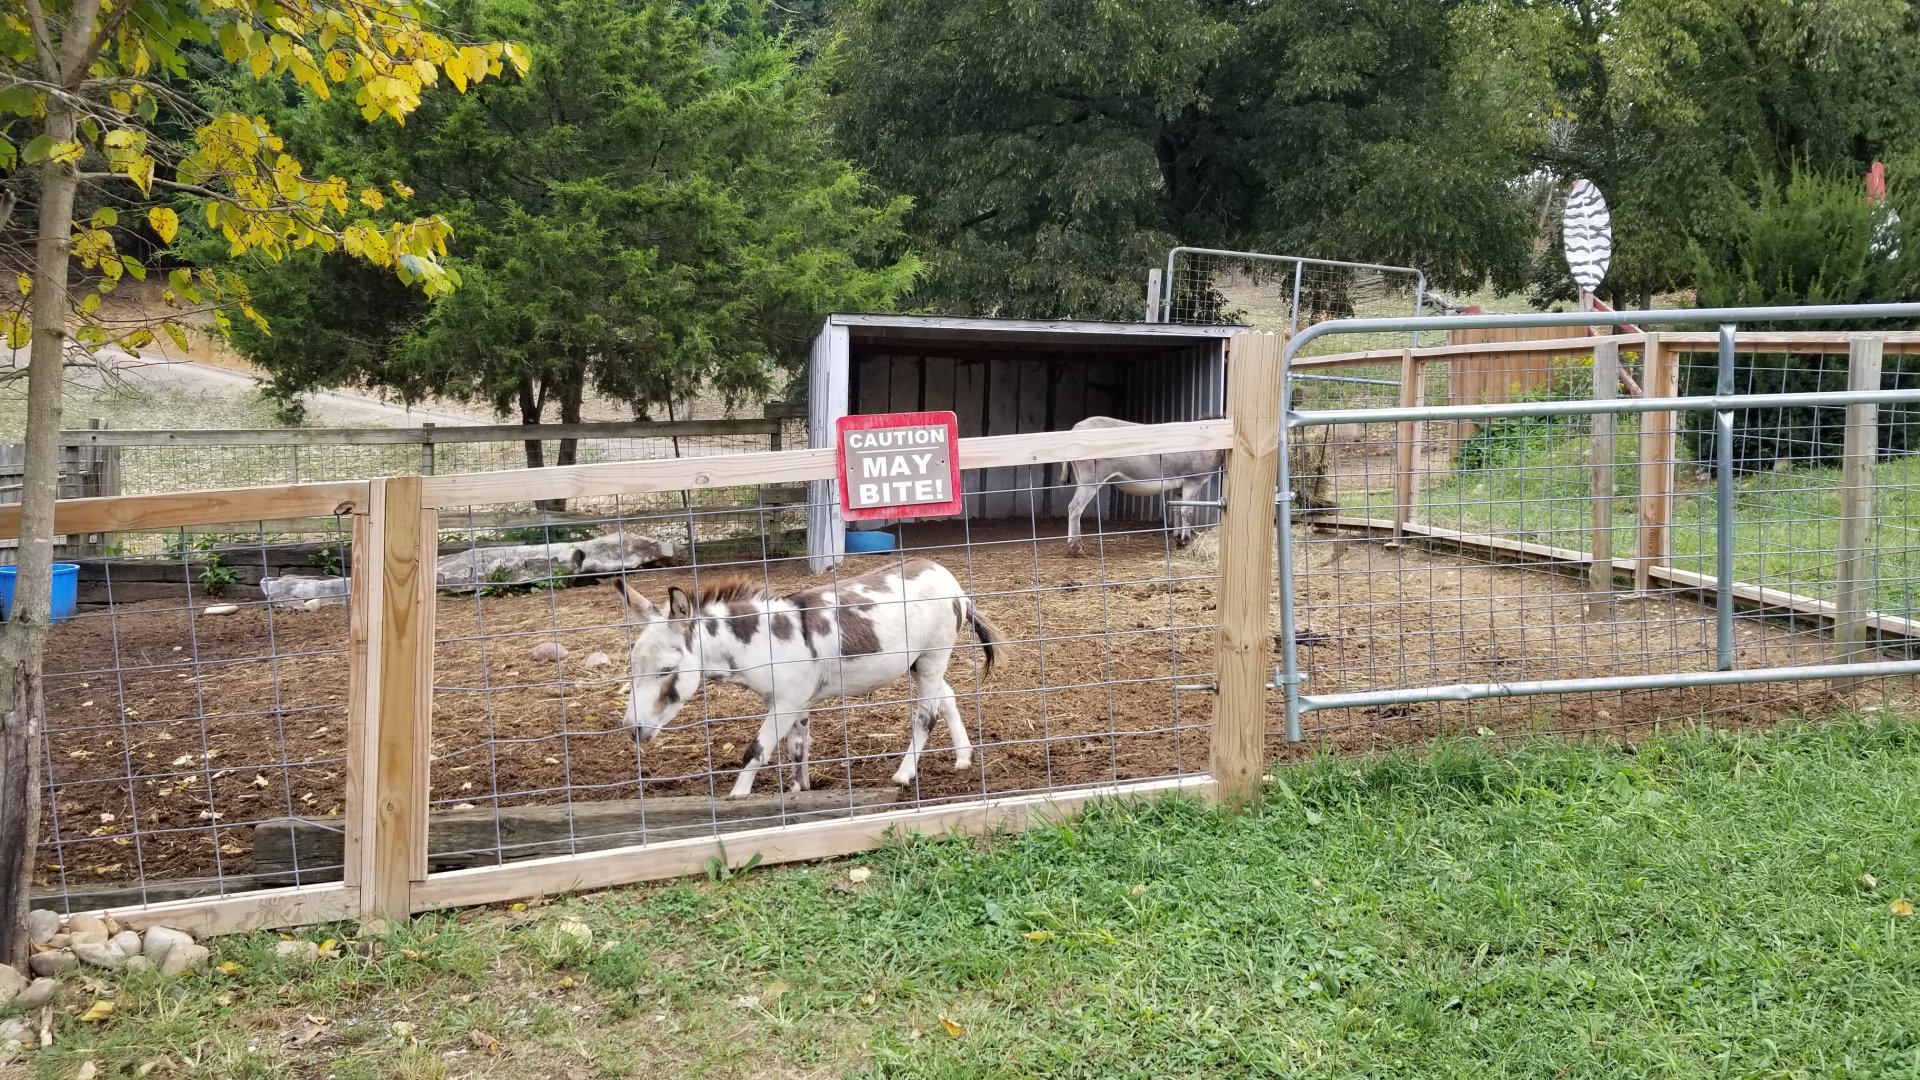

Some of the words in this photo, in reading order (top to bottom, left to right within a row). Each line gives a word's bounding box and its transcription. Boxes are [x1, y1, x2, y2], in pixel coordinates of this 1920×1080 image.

[849, 429, 945, 448] CAUTION
[862, 453, 933, 478] MAY
[860, 479, 944, 504] BITE!
